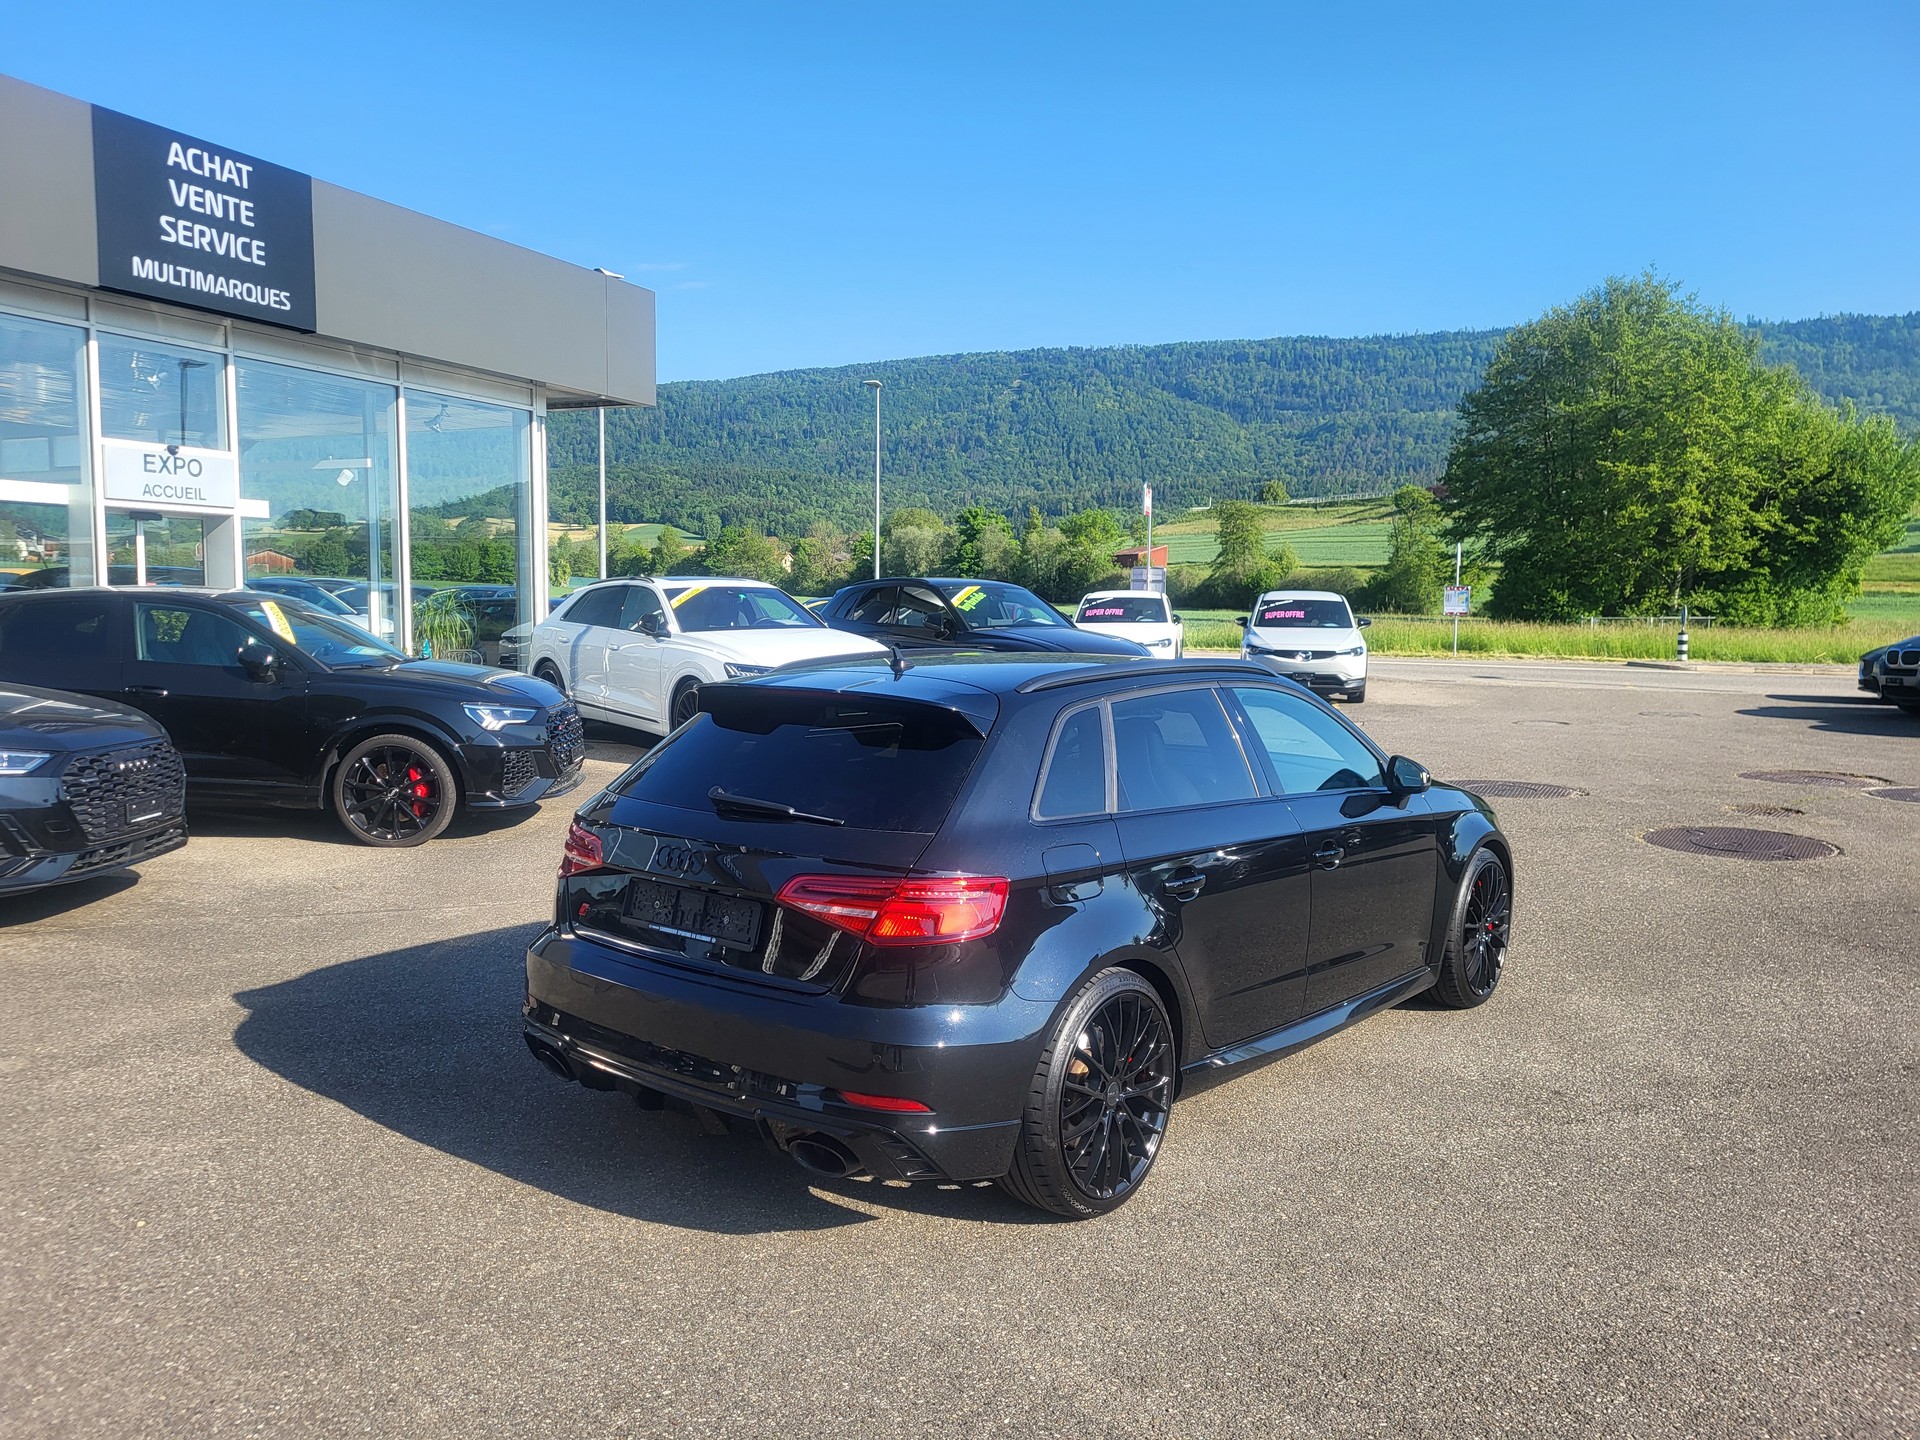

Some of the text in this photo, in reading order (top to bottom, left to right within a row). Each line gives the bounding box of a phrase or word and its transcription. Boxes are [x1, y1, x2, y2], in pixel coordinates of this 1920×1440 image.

[167, 141, 253, 189] ACHAT
[168, 178, 255, 227] VENTE
[159, 215, 266, 266] SERVICE
[131, 255, 291, 311] MULTIMARQUES
[143, 453, 203, 477] EXPO
[142, 483, 207, 501] ACCUEIL
[1085, 608, 1124, 617] SUPER OFFRE
[1264, 610, 1305, 619] SUPER OFFRE
